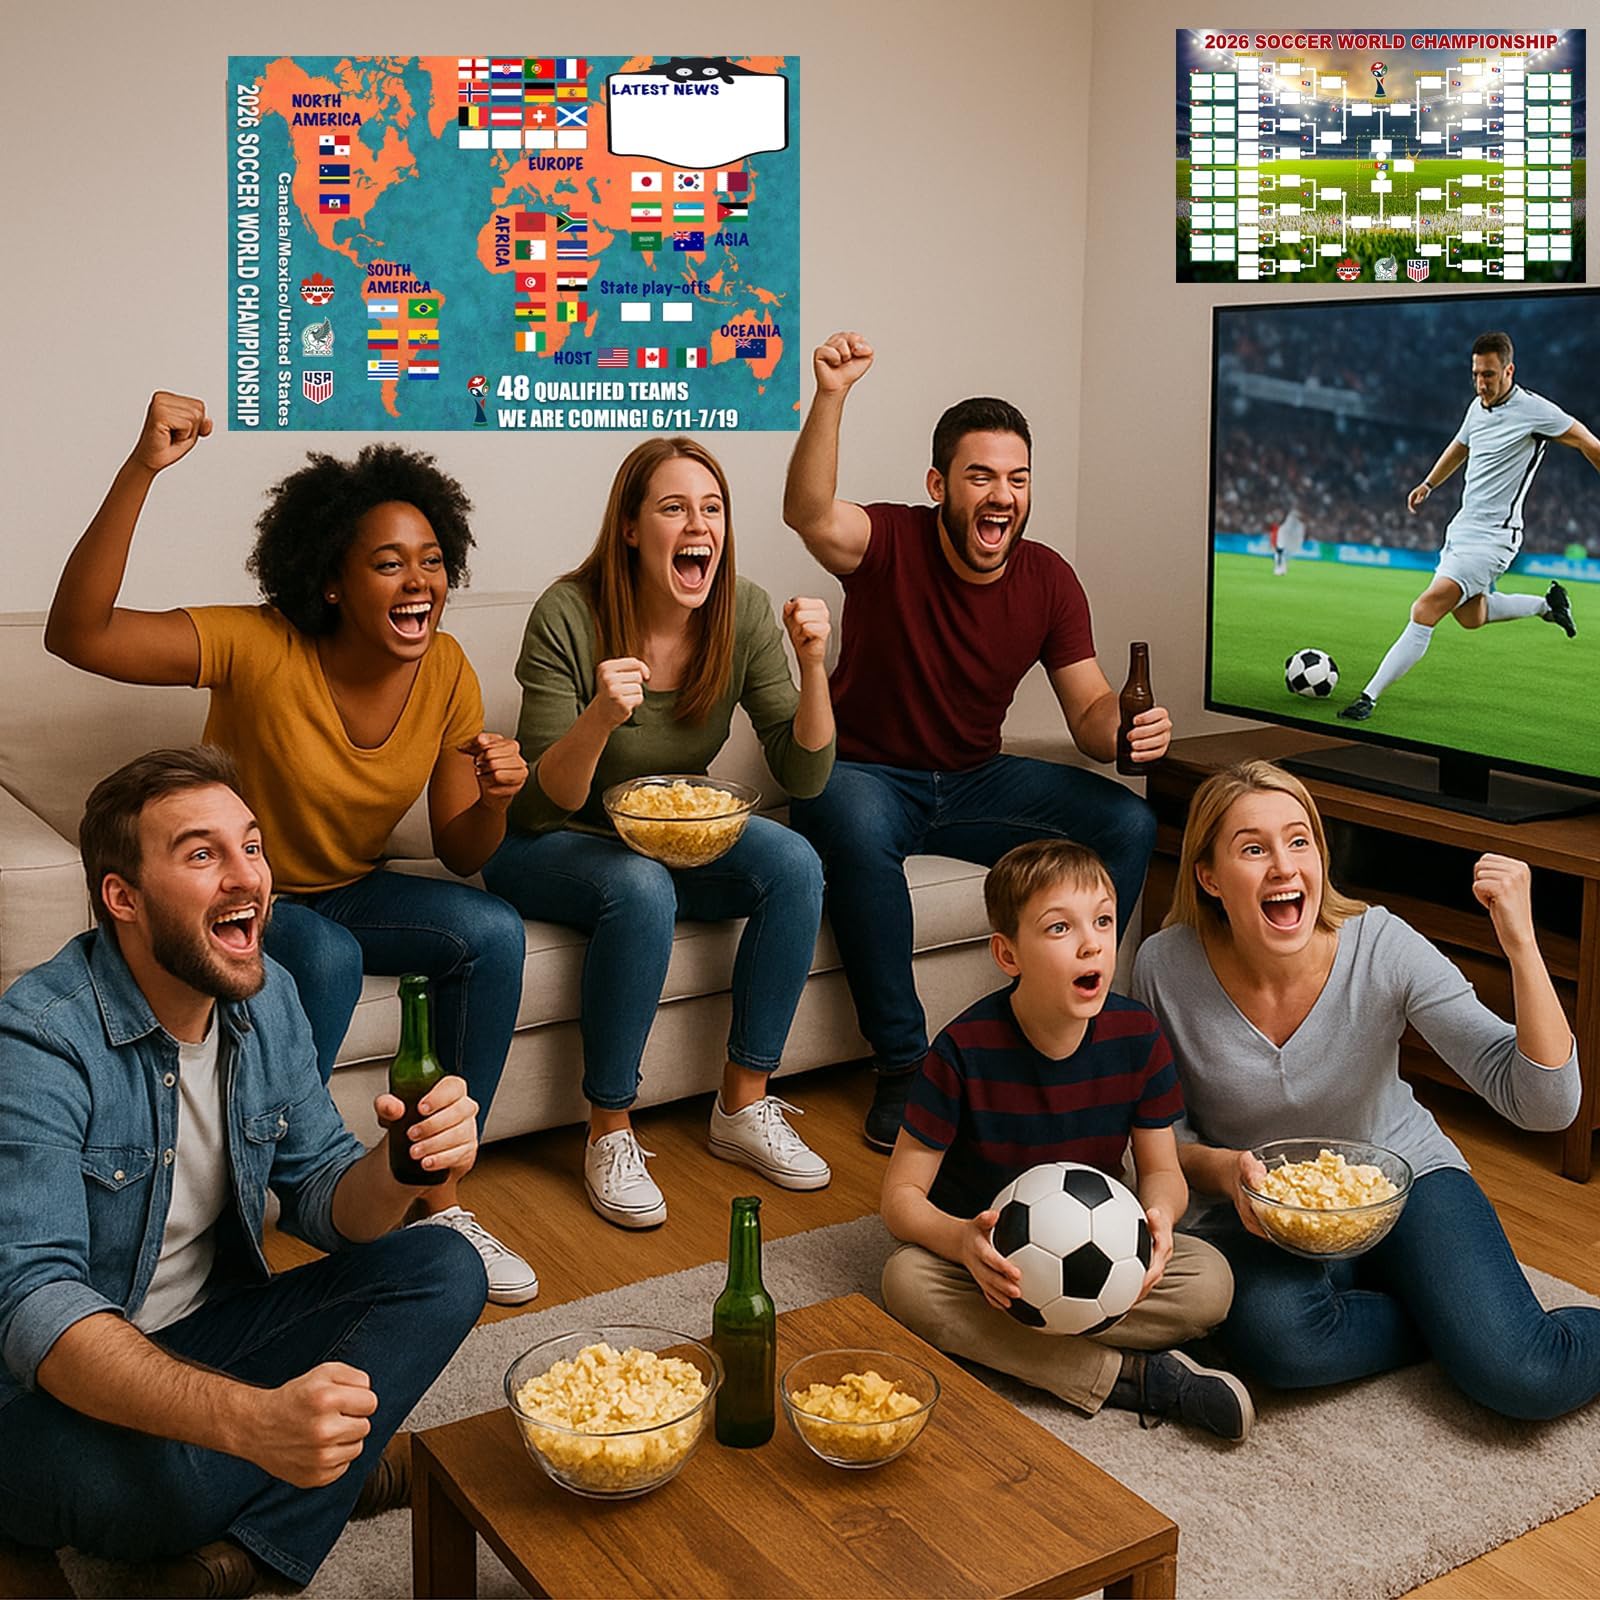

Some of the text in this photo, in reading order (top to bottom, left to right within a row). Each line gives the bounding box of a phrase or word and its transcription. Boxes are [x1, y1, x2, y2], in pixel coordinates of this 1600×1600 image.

[1204, 34, 1558, 49] 2026 SOCCER WORLD CHAMPIONSHIP
[611, 84, 720, 96] LATEST NEWS
[292, 94, 341, 108] NORTH
[292, 113, 362, 127] AMERICA
[528, 157, 584, 171] EUROPE
[495, 215, 510, 267] AFRICA
[714, 232, 749, 247] ASIA
[237, 84, 259, 427] 2026 SOCCER WORLD CHAMPIONSHIP
[367, 264, 411, 277] SOUTH
[1408, 261, 1427, 269] USA
[367, 281, 431, 294] AMERICA
[600, 281, 711, 298] State play-offs
[278, 172, 292, 427] Canada/Mexico/United States
[720, 324, 781, 338] OCEANIA
[554, 351, 593, 365] HOST
[304, 373, 332, 386] USA
[496, 375, 690, 402] 48 QUALIFIED TEAMS
[497, 409, 739, 429] WE ARE COMING! 6/11-7/19
